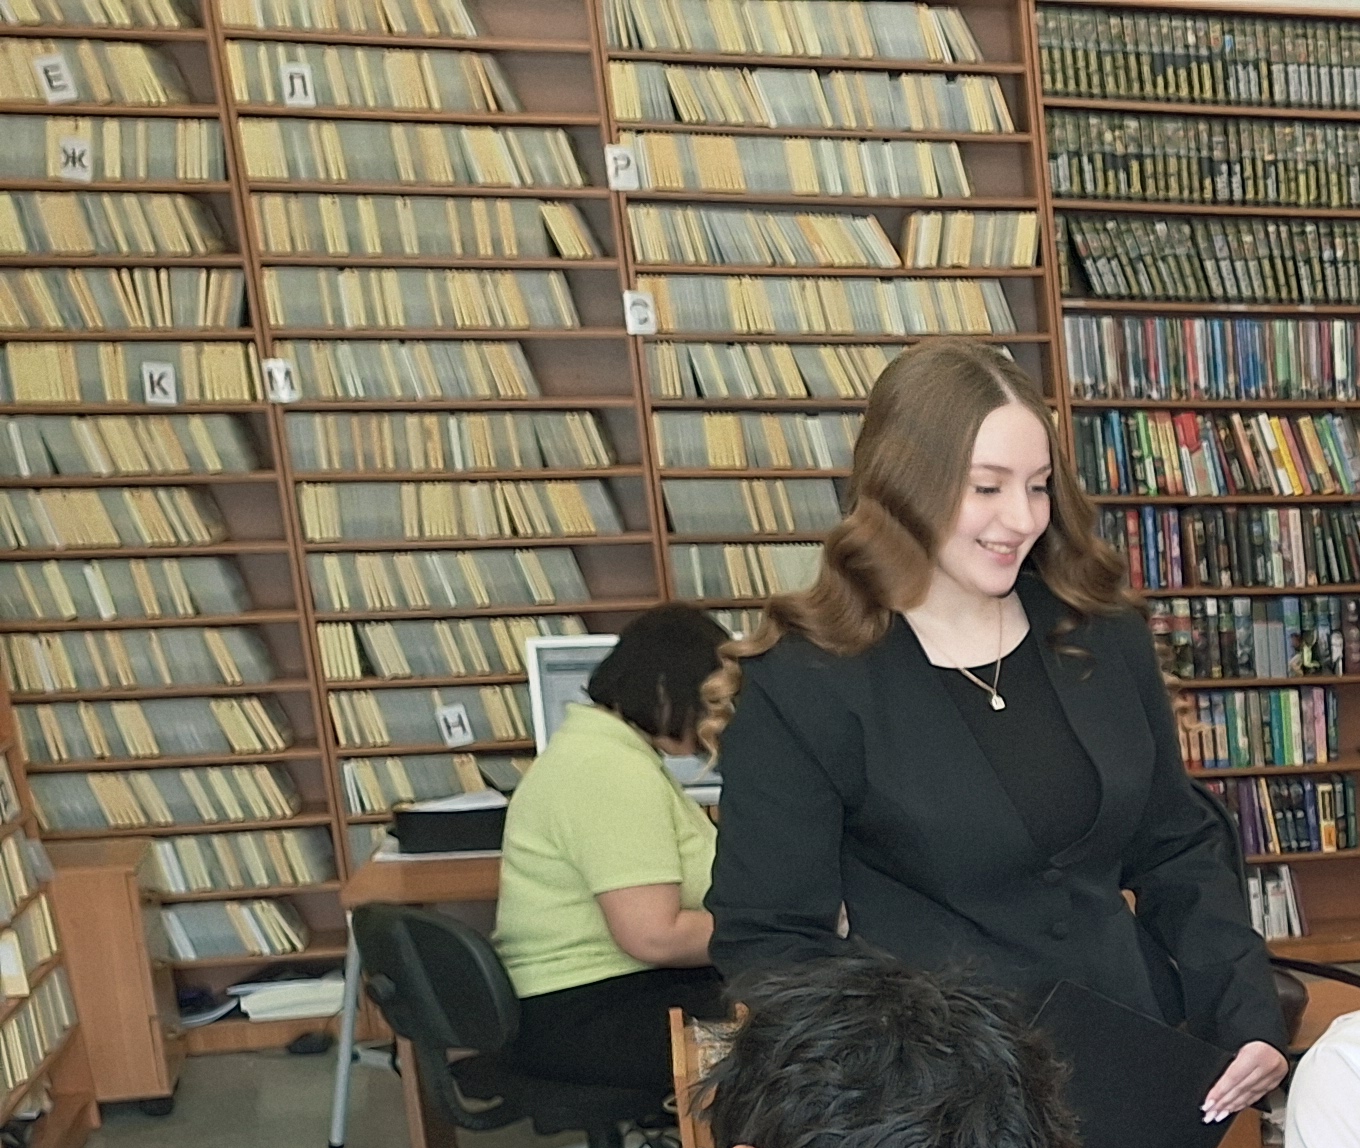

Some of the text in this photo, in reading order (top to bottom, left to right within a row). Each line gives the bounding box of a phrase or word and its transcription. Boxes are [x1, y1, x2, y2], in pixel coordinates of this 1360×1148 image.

[61, 147, 87, 170] Ж
[148, 371, 166, 394] К
[443, 717, 463, 736] Н
